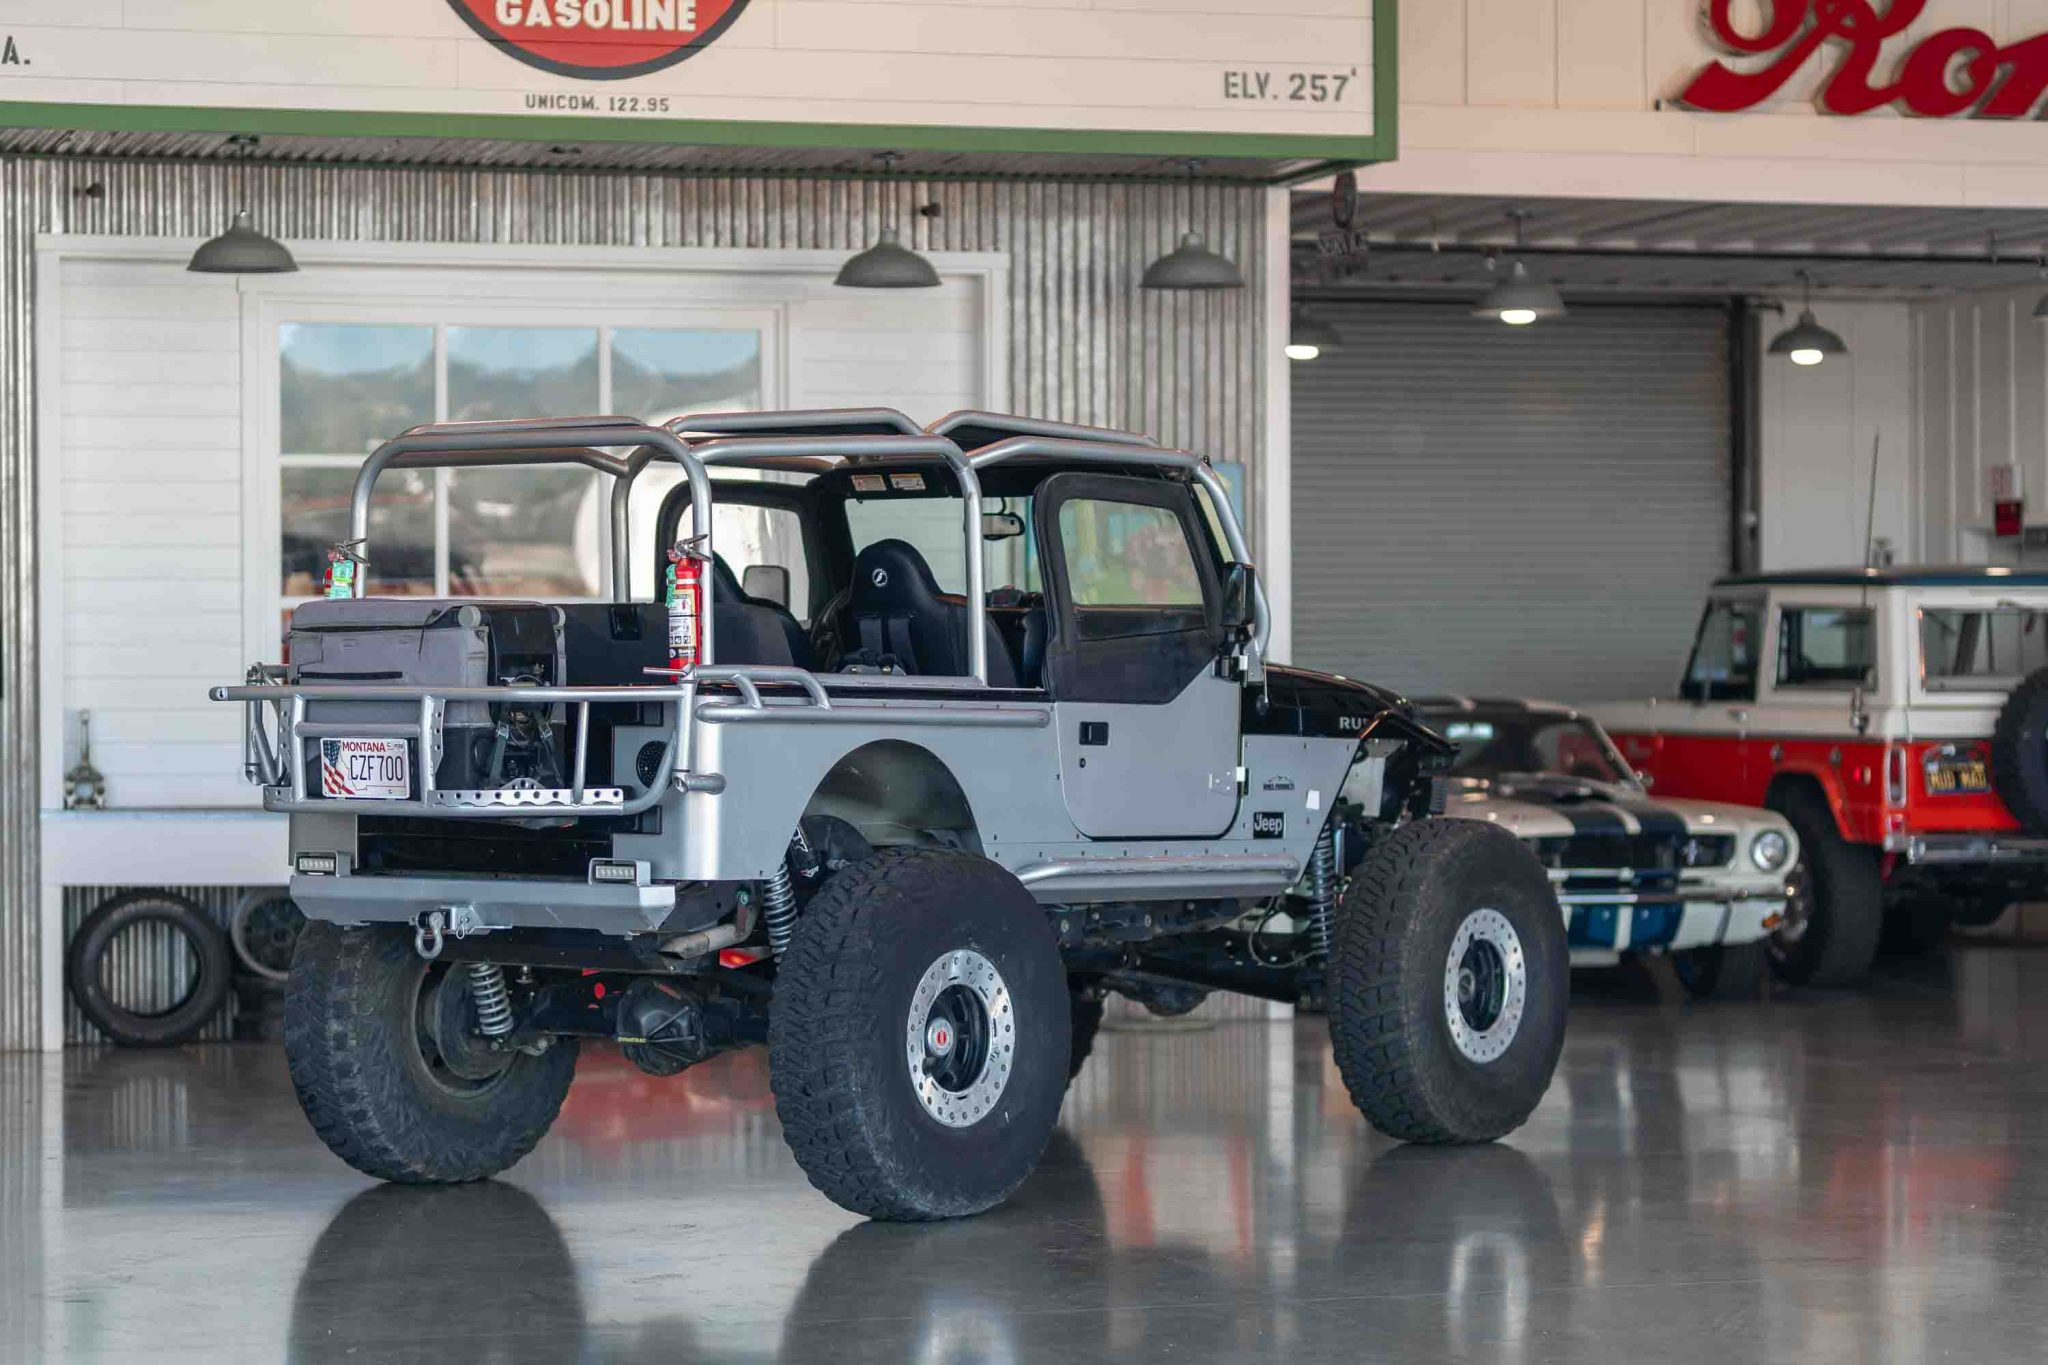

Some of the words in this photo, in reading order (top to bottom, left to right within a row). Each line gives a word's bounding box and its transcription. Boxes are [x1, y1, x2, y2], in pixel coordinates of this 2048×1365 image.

[495, 0, 697, 32] GASOLINE
[1224, 71, 1278, 99] ELV.
[609, 97, 670, 112] 122.95
[342, 741, 386, 752] MONTANA
[350, 755, 403, 781] CZF700
[1254, 813, 1283, 835] Jeep
